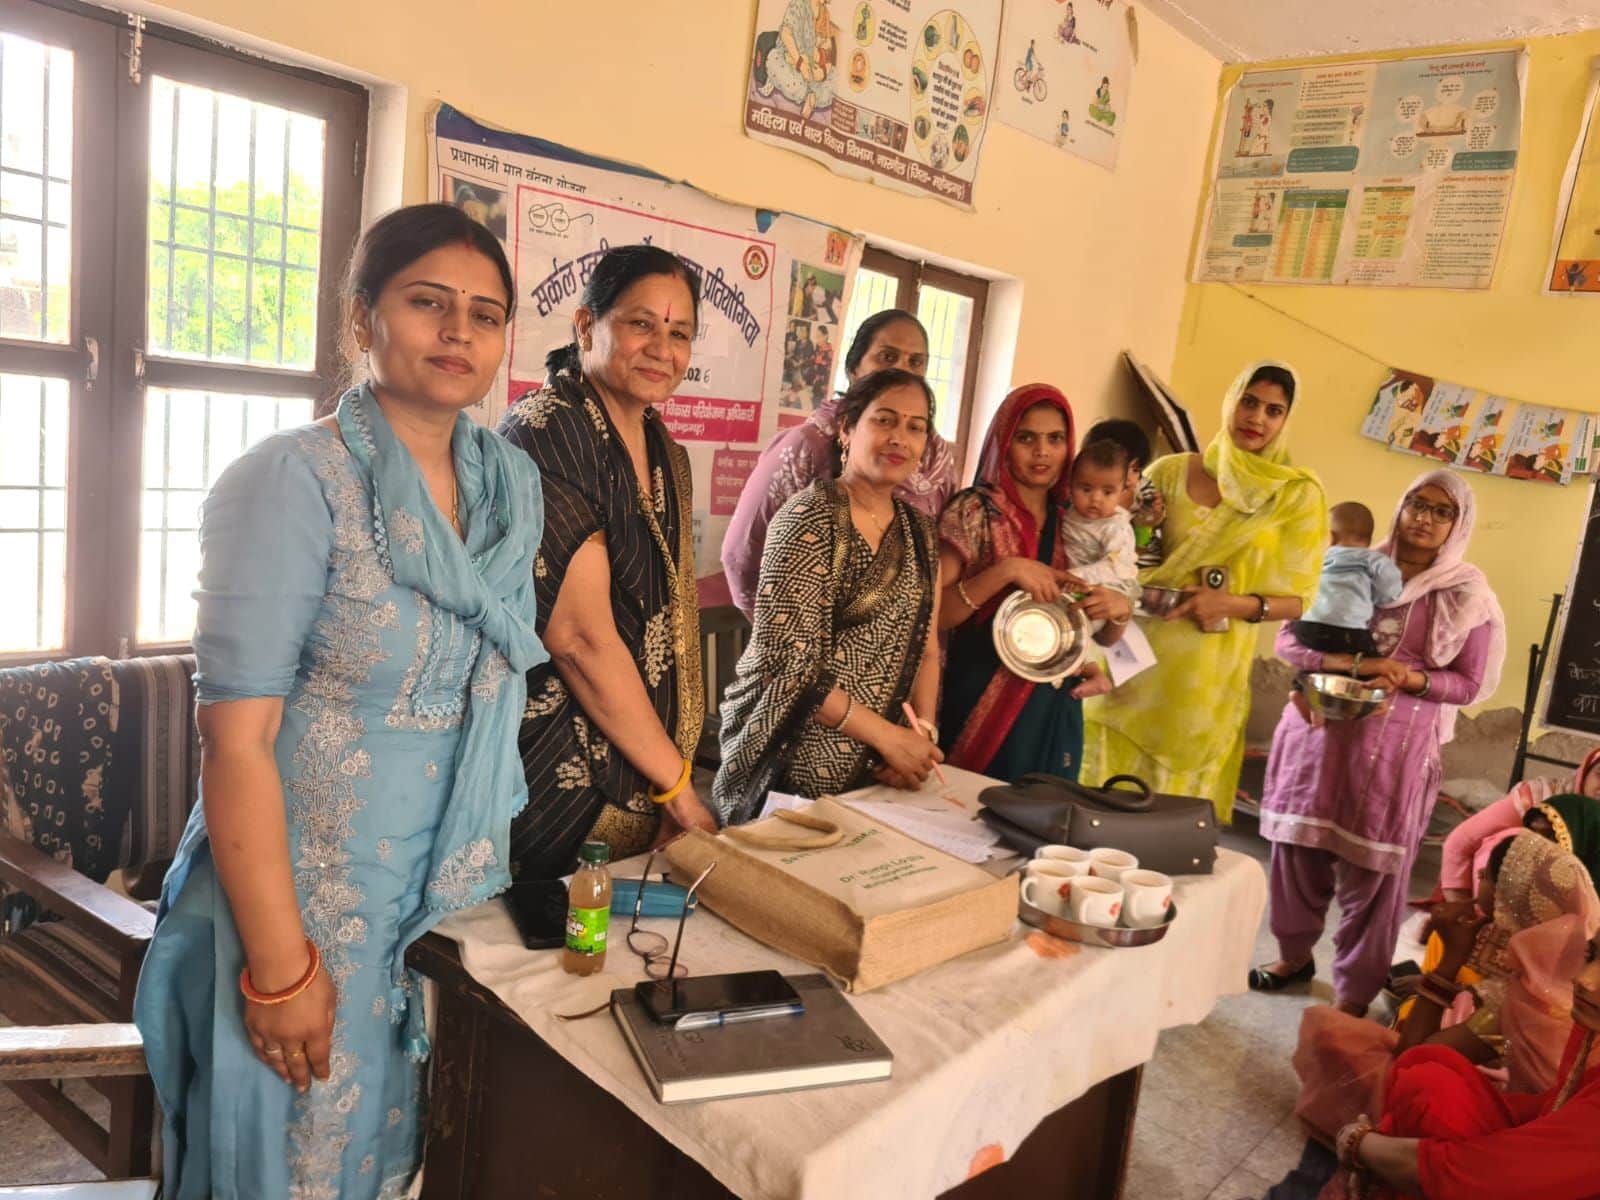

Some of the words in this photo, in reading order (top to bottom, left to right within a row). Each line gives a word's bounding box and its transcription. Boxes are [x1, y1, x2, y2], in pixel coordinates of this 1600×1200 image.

[751, 107, 786, 132] महिला
[789, 119, 804, 136] एवं
[804, 125, 823, 143] बाल
[823, 128, 845, 153] विकास
[450, 147, 499, 174] प्रधानमंत्री
[702, 267, 761, 348] प्रतियोगिता
[666, 397, 691, 417] विकास
